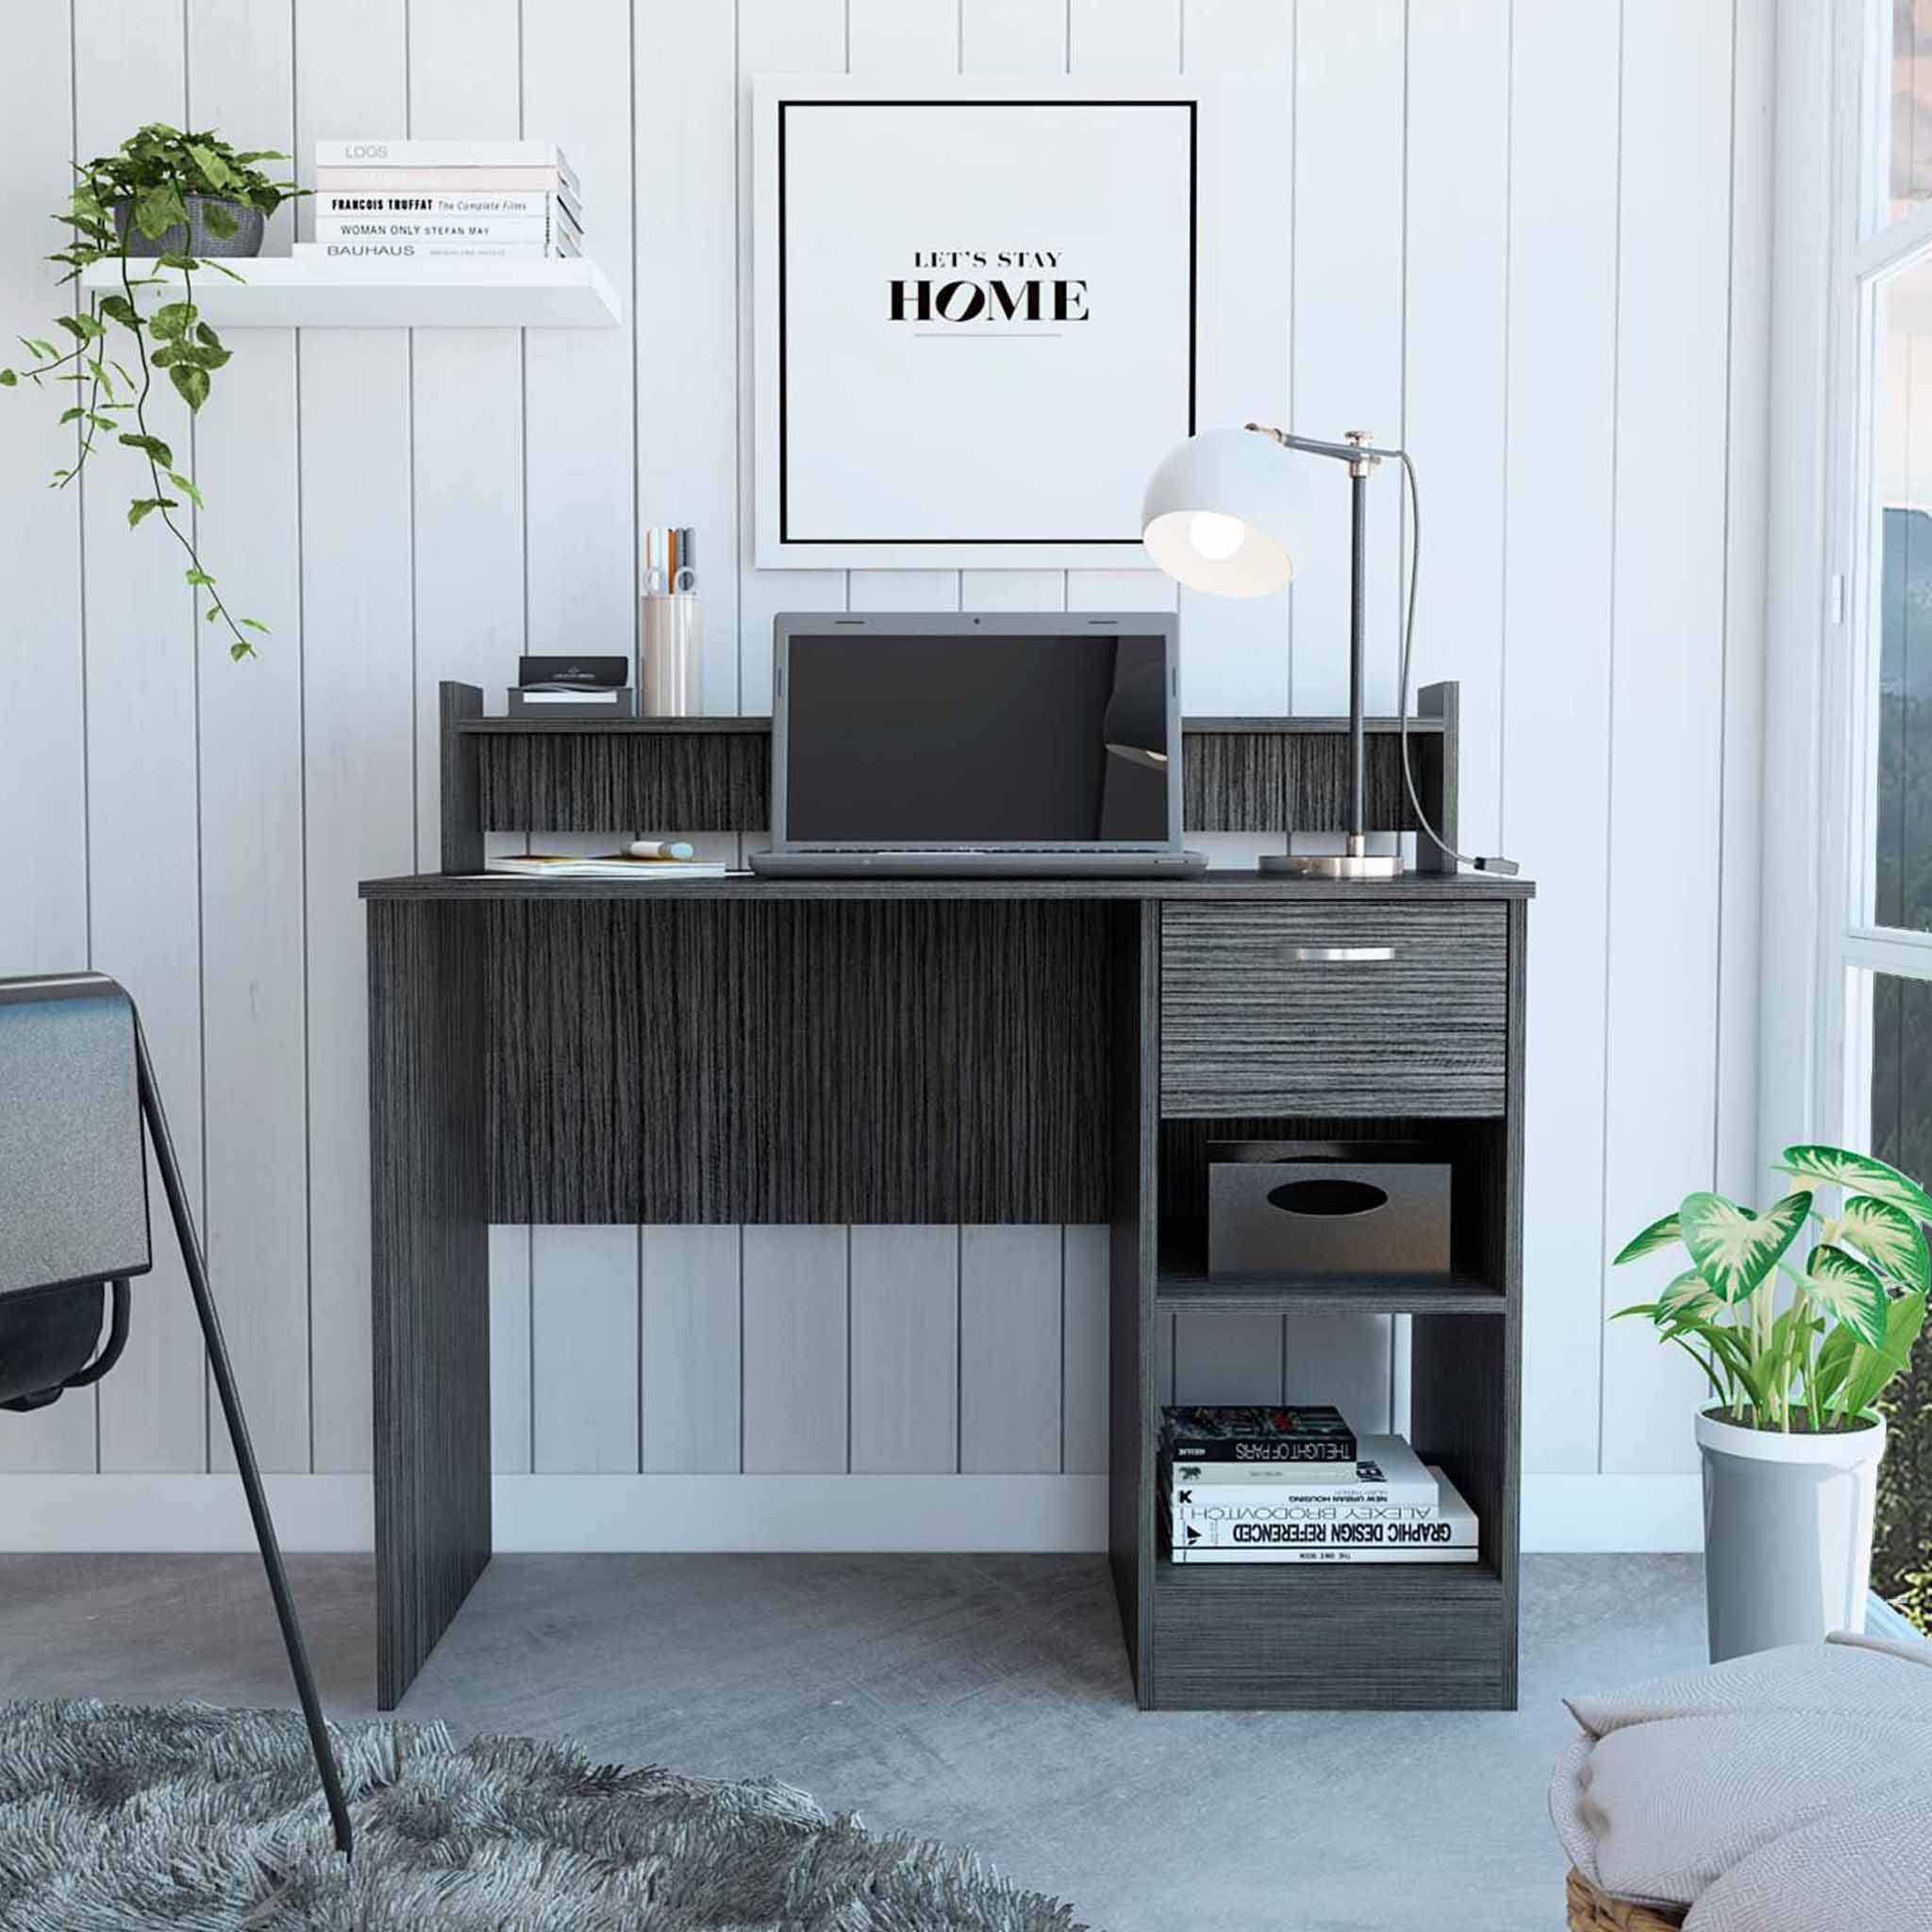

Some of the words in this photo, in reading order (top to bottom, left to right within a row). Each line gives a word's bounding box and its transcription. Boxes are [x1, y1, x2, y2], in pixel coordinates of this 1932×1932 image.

[344, 145, 389, 159] LOOS
[331, 199, 384, 211] FRANCOIS
[388, 199, 434, 210] TRUFFAT
[341, 225, 388, 236] WOMAN
[390, 225, 422, 236] ONLY
[424, 225, 465, 236] STEFAN
[326, 244, 416, 257] BAUHAUS
[914, 250, 987, 268] LET'S
[997, 251, 1062, 268] STAY
[887, 279, 1091, 323] HOME
[1327, 1443, 1352, 1459] THE
[1191, 1507, 1337, 1522] BRODOVITCH
[1343, 1507, 1431, 1521] ALEXEY
[1233, 1524, 1326, 1542] REFERENCED
[1331, 1524, 1383, 1542] DESIGN
[1389, 1524, 1452, 1542] GRAPHIC
